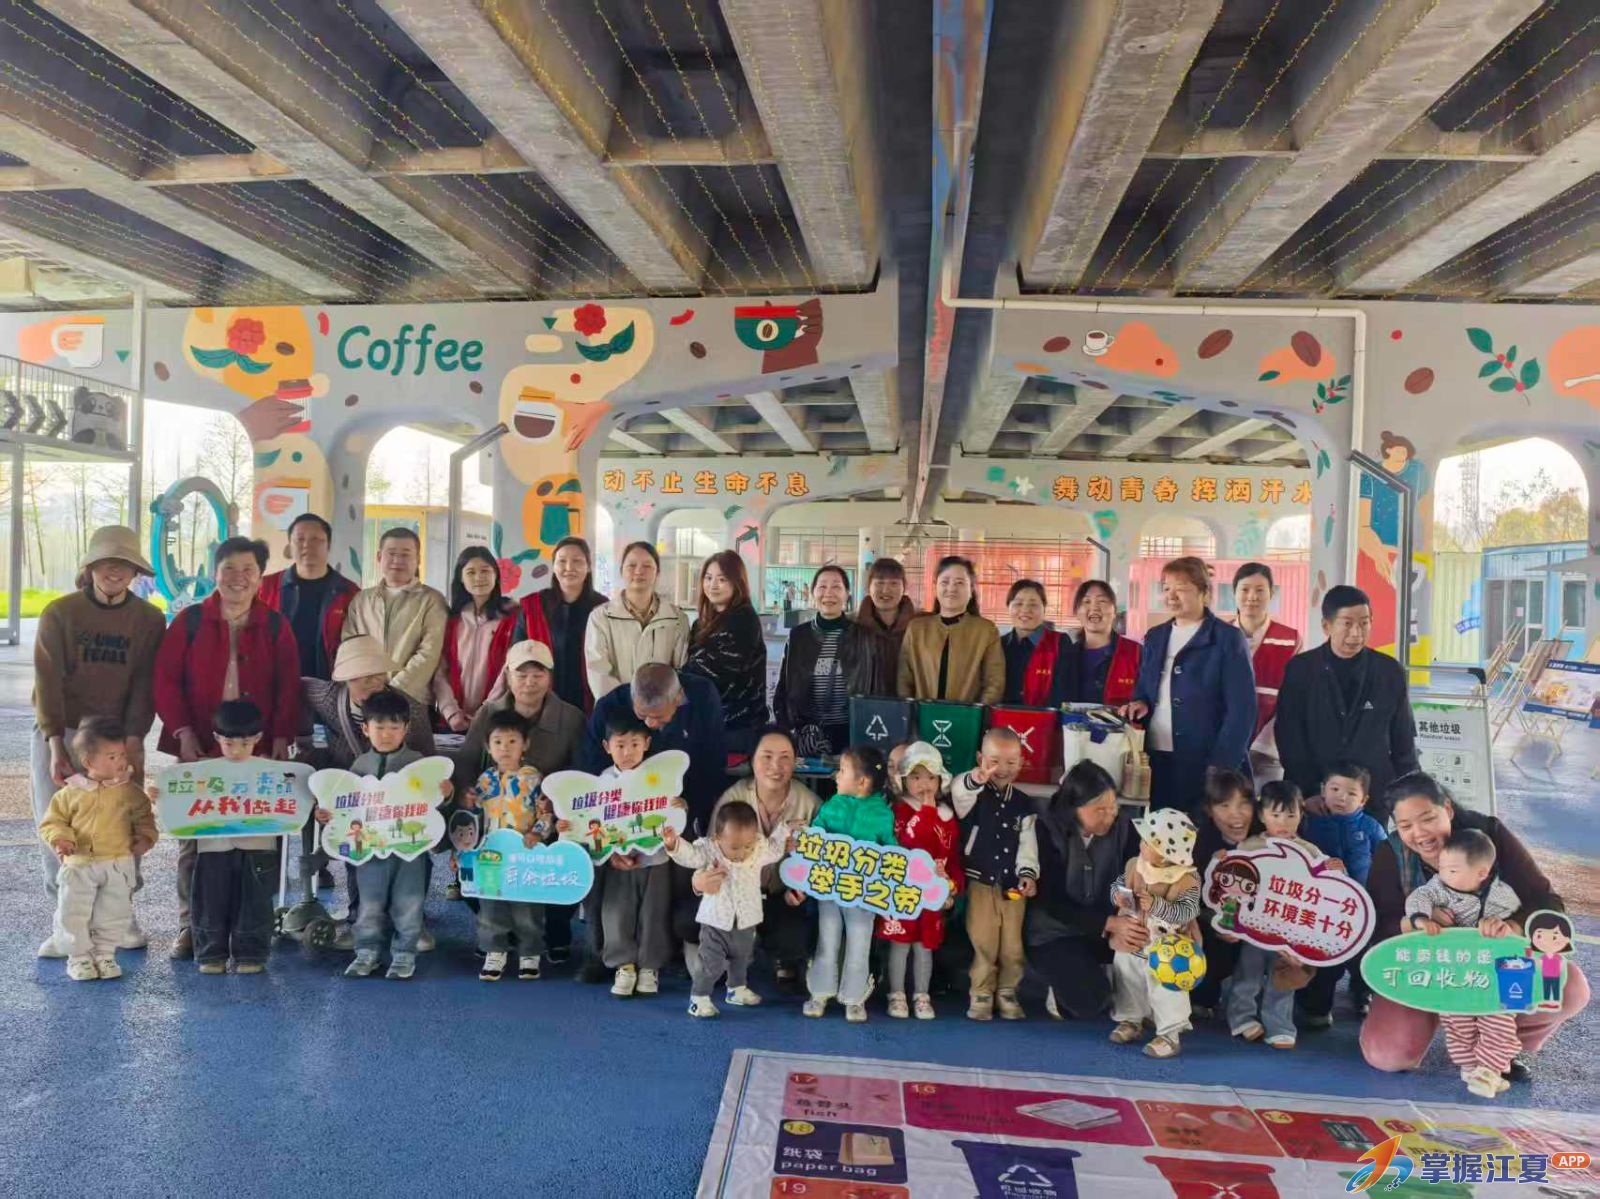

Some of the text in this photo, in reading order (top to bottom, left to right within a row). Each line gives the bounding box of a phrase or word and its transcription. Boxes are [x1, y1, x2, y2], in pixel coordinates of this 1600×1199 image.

[337, 323, 484, 376] Coffee
[603, 469, 810, 496] 动不止 生命不息
[1053, 476, 1312, 504] 舞动青春 挥洒汗水
[1419, 721, 1461, 734] 其他垃圾
[187, 796, 298, 816] 从我做起
[572, 788, 622, 810] 垃圾分类
[603, 796, 668, 821] 健康你我他
[797, 832, 908, 883] 垃圾分类
[808, 863, 922, 915] 举手之劳
[1268, 875, 1358, 916] 垃圾分一分
[1263, 898, 1353, 940] 环境美十分
[1382, 967, 1490, 989] 可回收物
[783, 1147, 822, 1160] 纸袋
[781, 1161, 877, 1176] paper bag
[779, 1182, 806, 1194] 19
